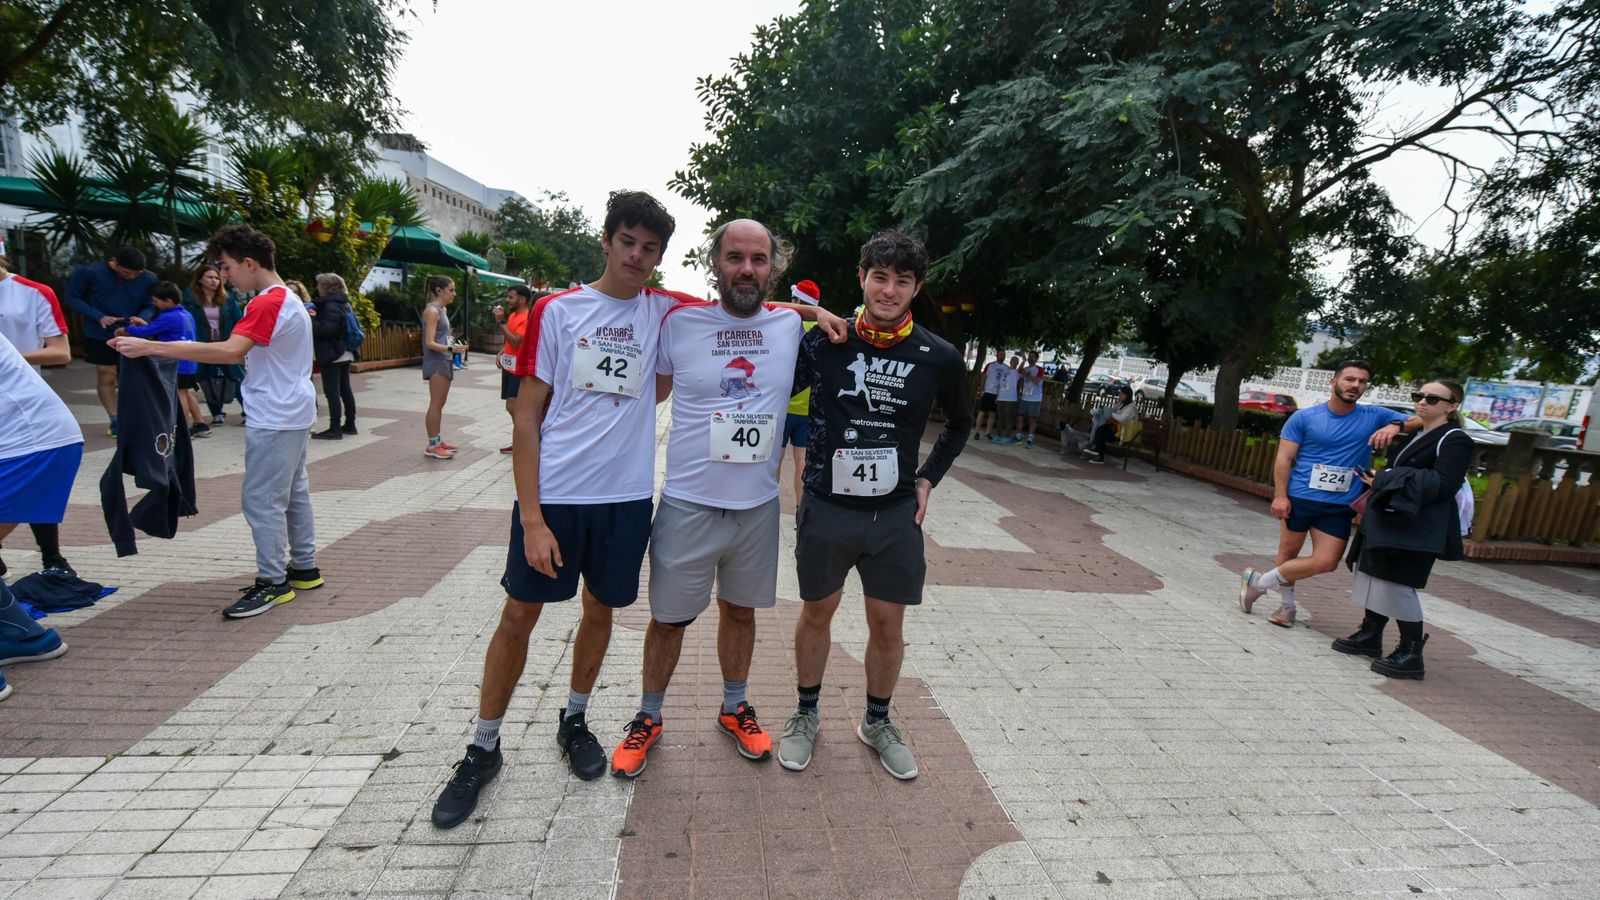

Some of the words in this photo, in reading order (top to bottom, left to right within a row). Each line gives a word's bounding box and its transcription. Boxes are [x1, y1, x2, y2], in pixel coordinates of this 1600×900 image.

[717, 331, 723, 340] II
[724, 330, 763, 340] CARRERA
[597, 340, 612, 348] SAN
[614, 342, 642, 355] SILVESTRE
[717, 340, 730, 348] SAN
[731, 339, 763, 347] SILVESTRE
[596, 355, 628, 379] 42
[869, 357, 916, 378] XIV
[865, 372, 902, 383] CARRERA
[865, 378, 905, 389] ESTRECHO
[870, 389, 891, 397] PEPE
[870, 394, 908, 406] SERRANO
[731, 427, 760, 447] 40
[852, 463, 878, 482] 41
[1319, 472, 1346, 485] 224
